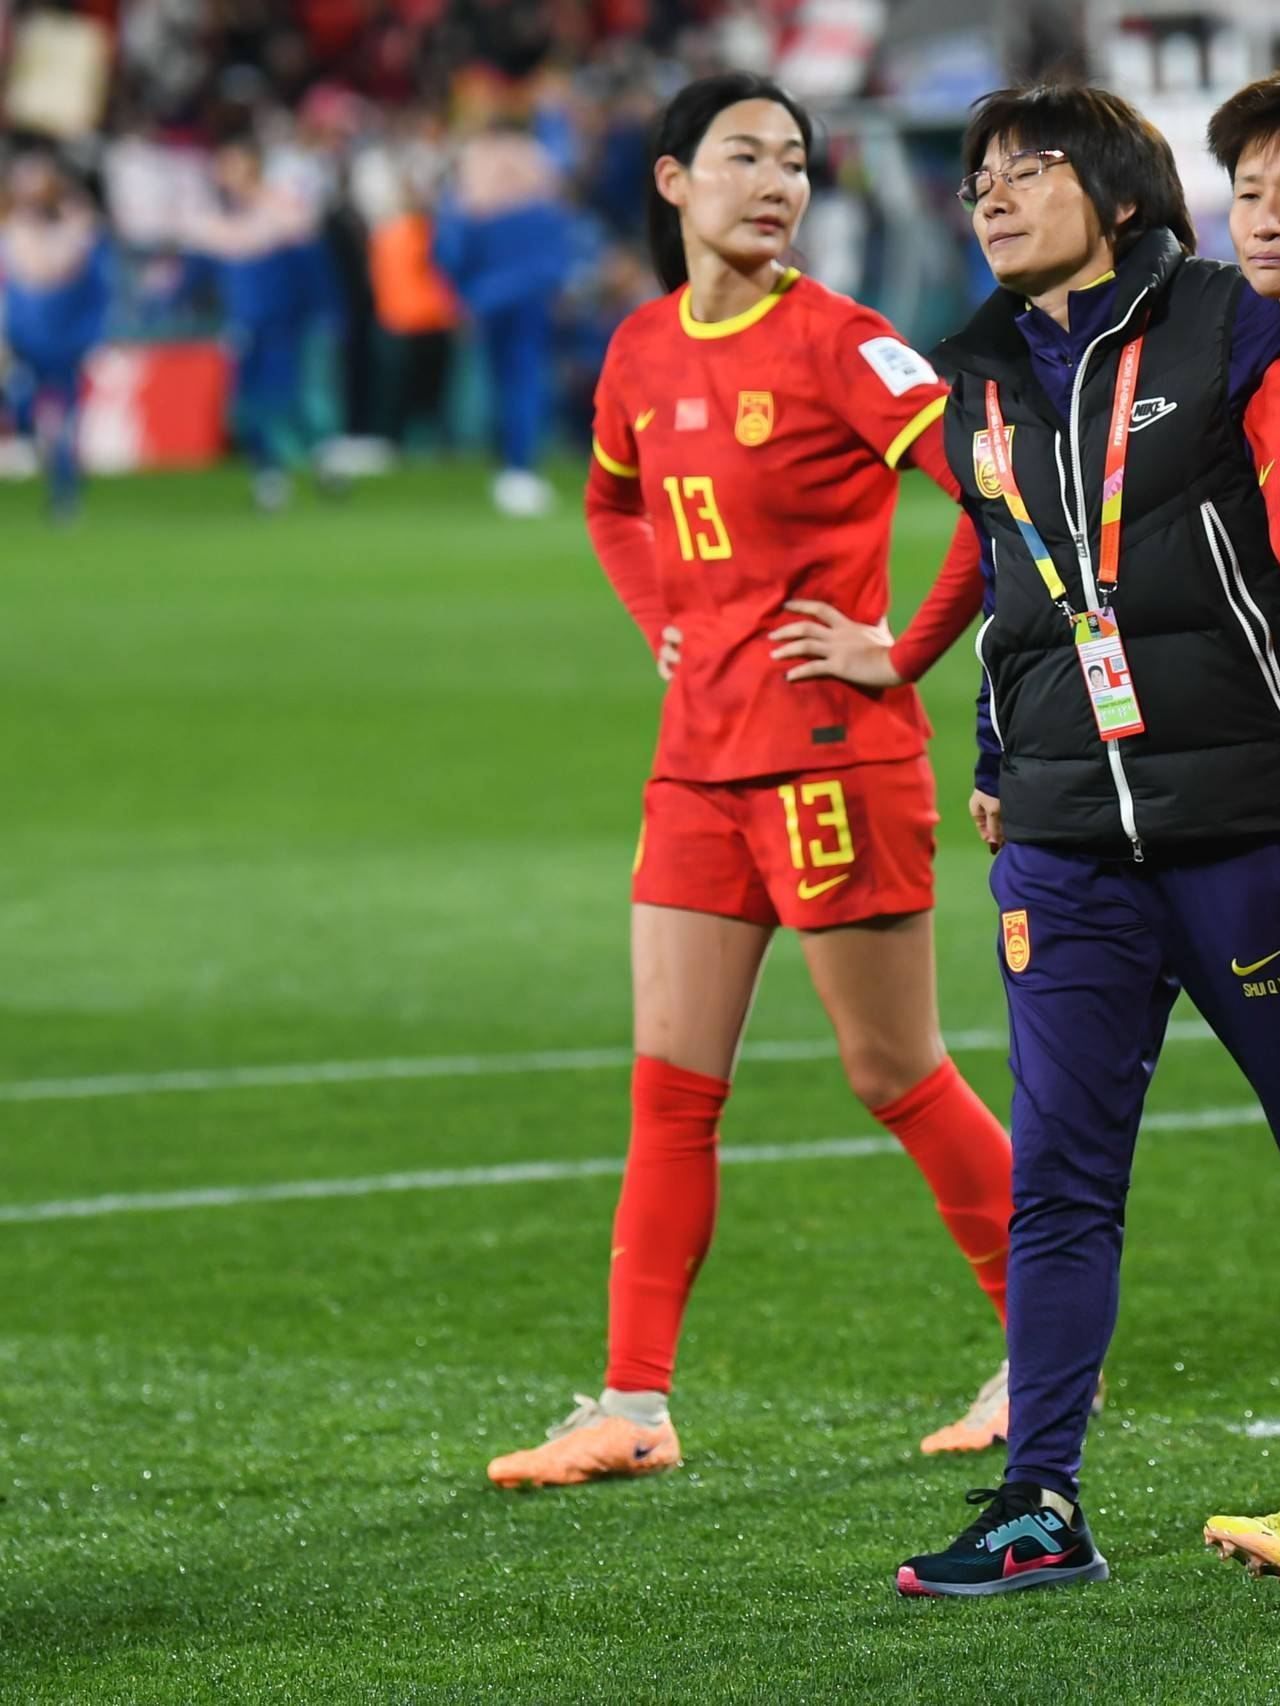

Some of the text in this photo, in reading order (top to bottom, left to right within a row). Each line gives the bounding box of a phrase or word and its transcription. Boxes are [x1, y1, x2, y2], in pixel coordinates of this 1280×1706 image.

[1113, 423, 1124, 446] FIFA
[1123, 344, 1136, 377] WORLD
[1133, 401, 1163, 417] NIKE
[663, 476, 732, 560] 13
[778, 780, 855, 869] 13
[1242, 982, 1267, 997] SHUI
[1267, 979, 1279, 994] Q
